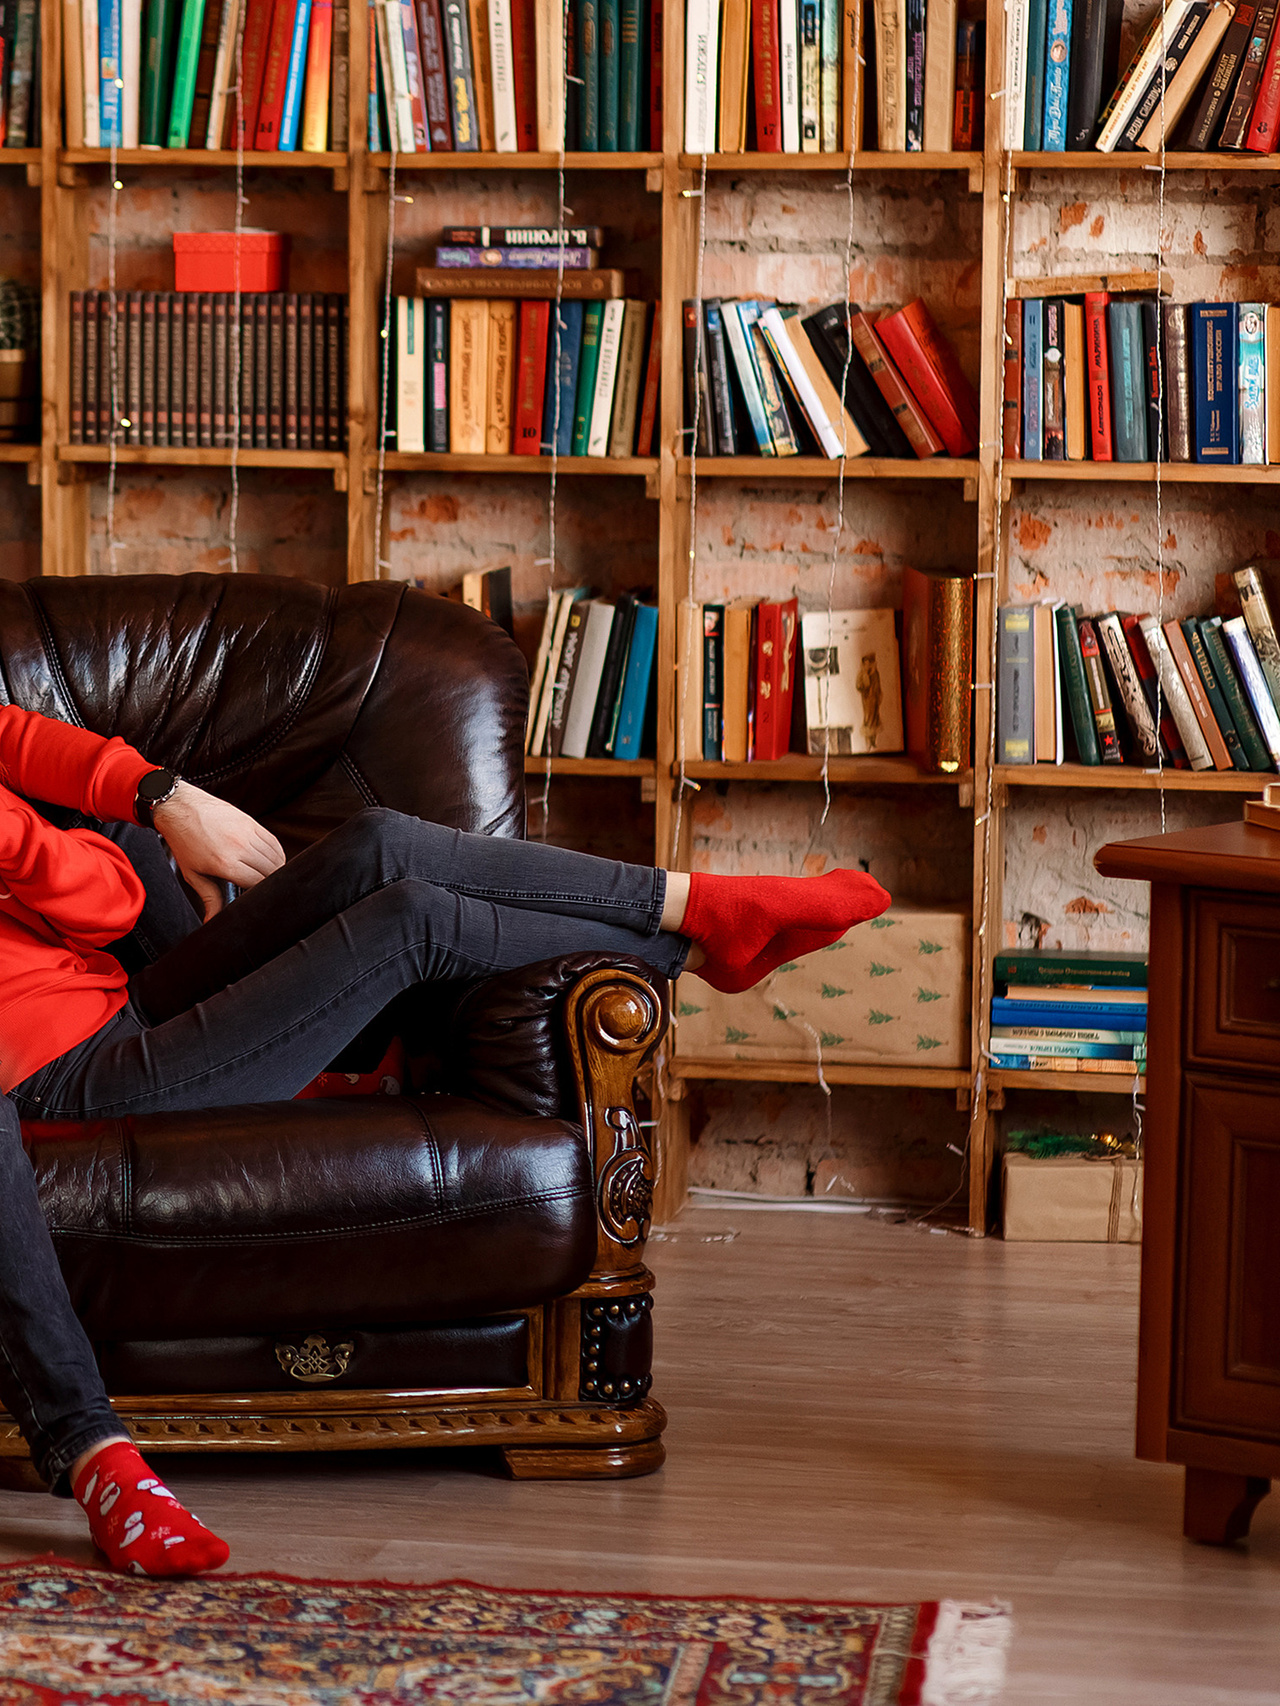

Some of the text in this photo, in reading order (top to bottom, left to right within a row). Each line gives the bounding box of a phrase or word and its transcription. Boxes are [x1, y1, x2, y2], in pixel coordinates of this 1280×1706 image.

[1213, 54, 1230, 87] СЕРЖАНТ
[1219, 54, 1238, 90] МИЛИЦИИ
[522, 427, 536, 438] 10
[1192, 632, 1216, 690] СТЕНДАЛЬ
